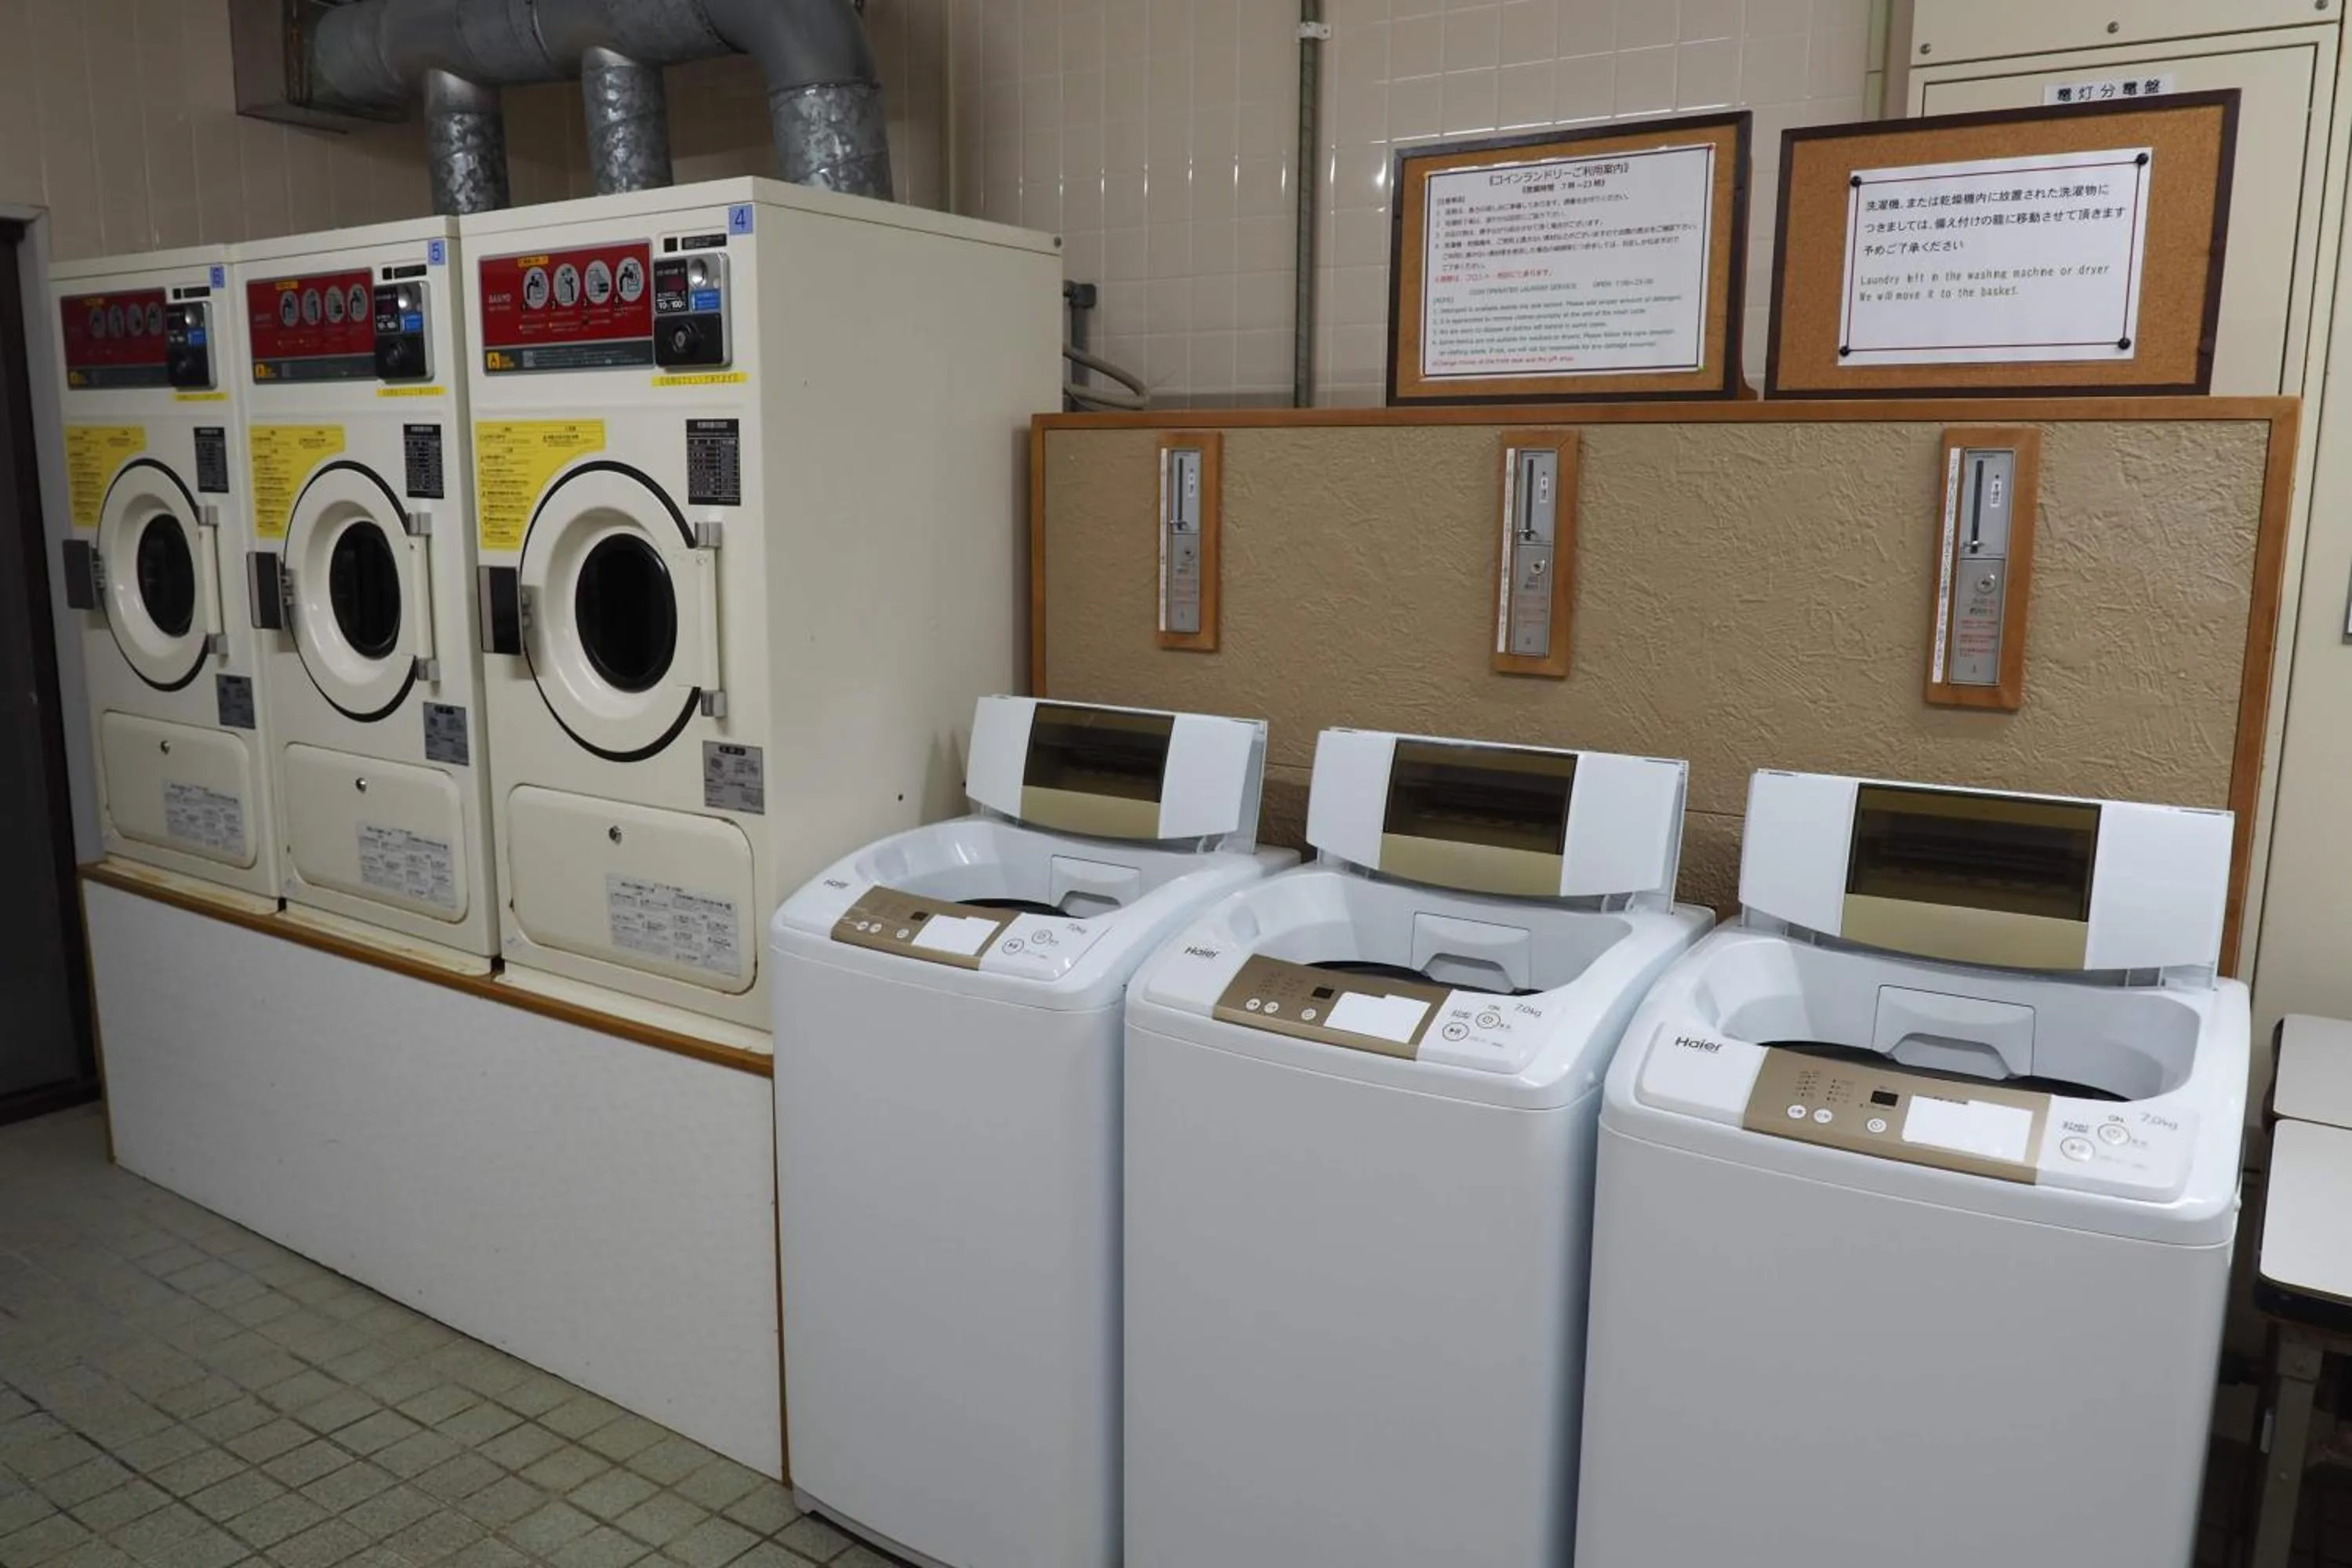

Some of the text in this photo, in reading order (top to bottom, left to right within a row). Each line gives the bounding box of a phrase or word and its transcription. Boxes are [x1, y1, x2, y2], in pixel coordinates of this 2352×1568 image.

[2057, 79, 2160, 102] 電灯分電盤
[735, 209, 746, 229] 4
[1864, 240, 1964, 257] 予めご了承ください
[1860, 275, 1900, 286] Laundry
[1945, 270, 1961, 281] the
[2060, 266, 2072, 276] or
[2078, 263, 2110, 277] dryer
[1860, 291, 1871, 302] We
[1896, 291, 1920, 301] move
[1940, 289, 1951, 299] to
[1958, 288, 1974, 298] the
[1185, 946, 1220, 958] Haier
[1675, 1036, 1723, 1052] Haier
